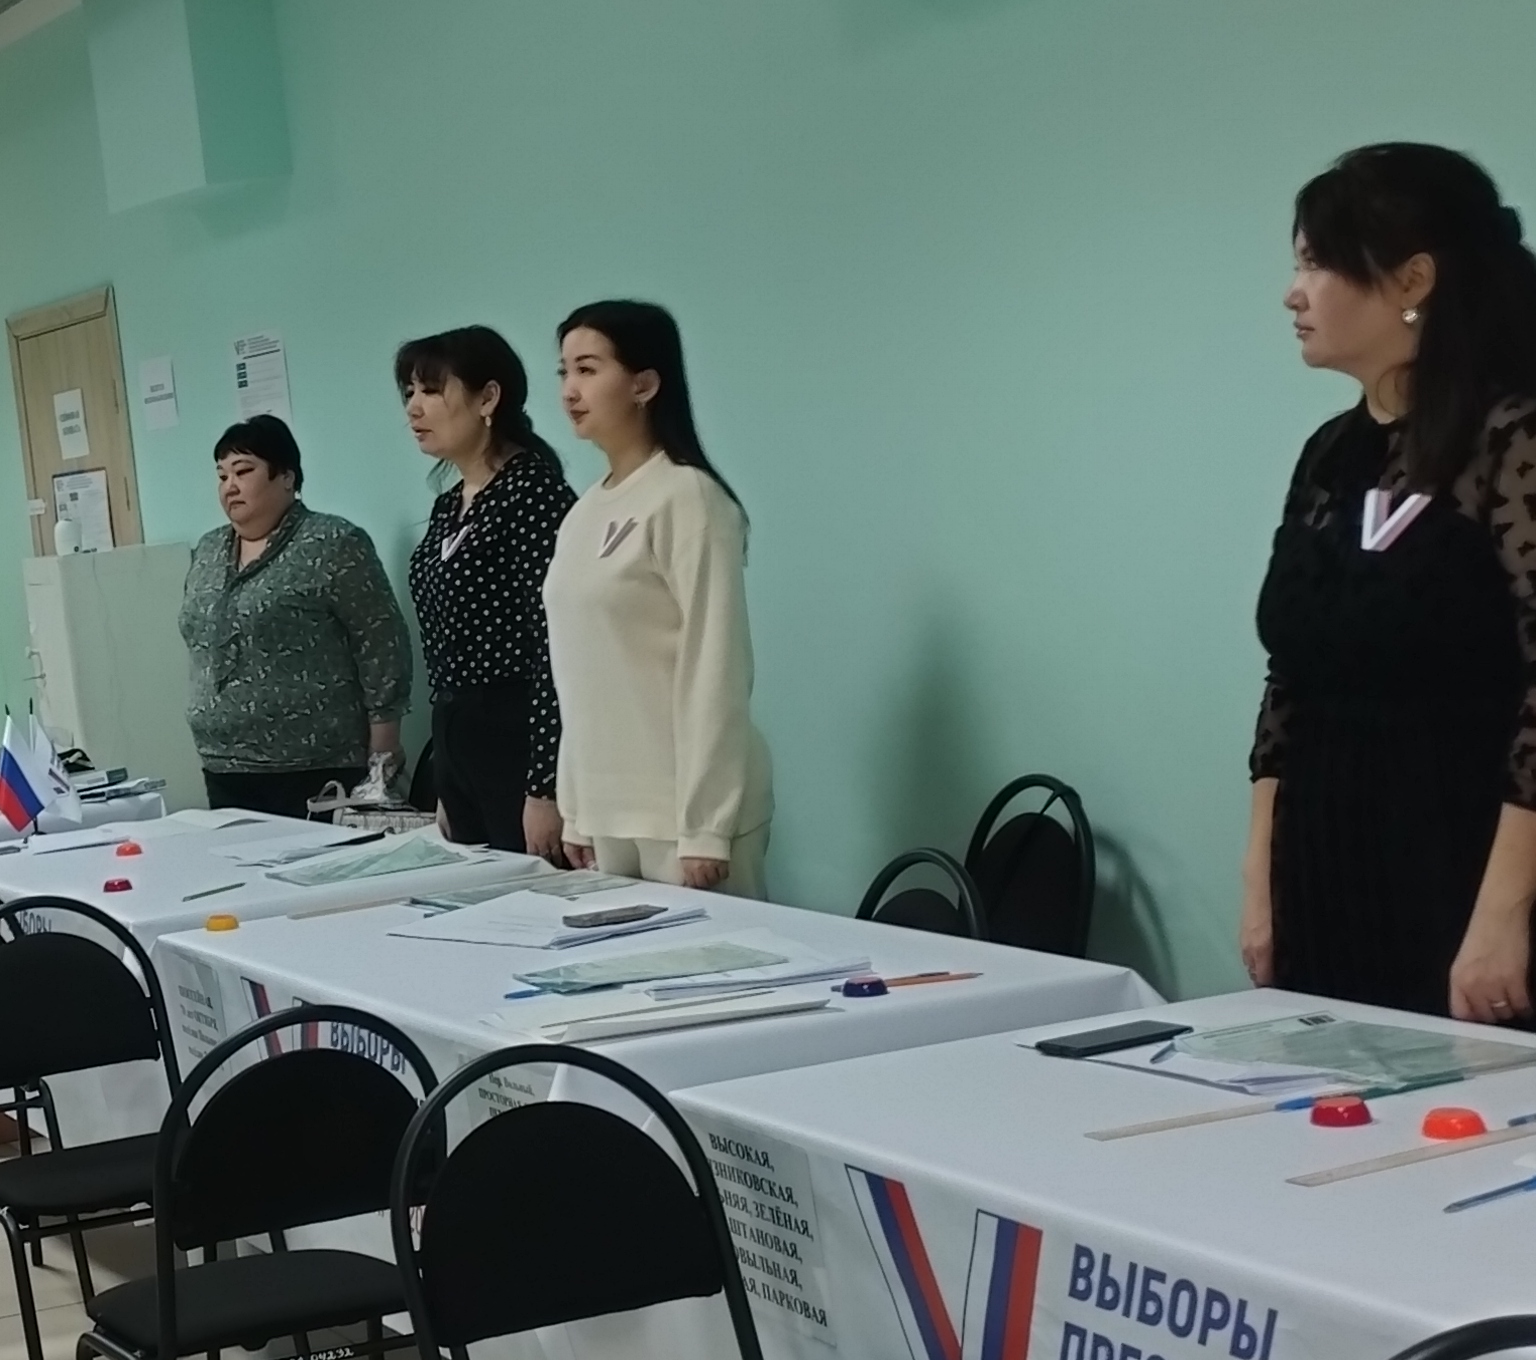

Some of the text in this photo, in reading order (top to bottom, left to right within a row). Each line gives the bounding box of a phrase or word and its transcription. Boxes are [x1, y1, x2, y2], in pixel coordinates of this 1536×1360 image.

[708, 1132, 774, 1172] ВЫСОКАЯ,
[728, 1216, 803, 1265] ШТАНОВАЯ,
[752, 1200, 814, 1242] ЗЕЛЁНАЯ,
[762, 1281, 828, 1327] ПАРКОВАЯ
